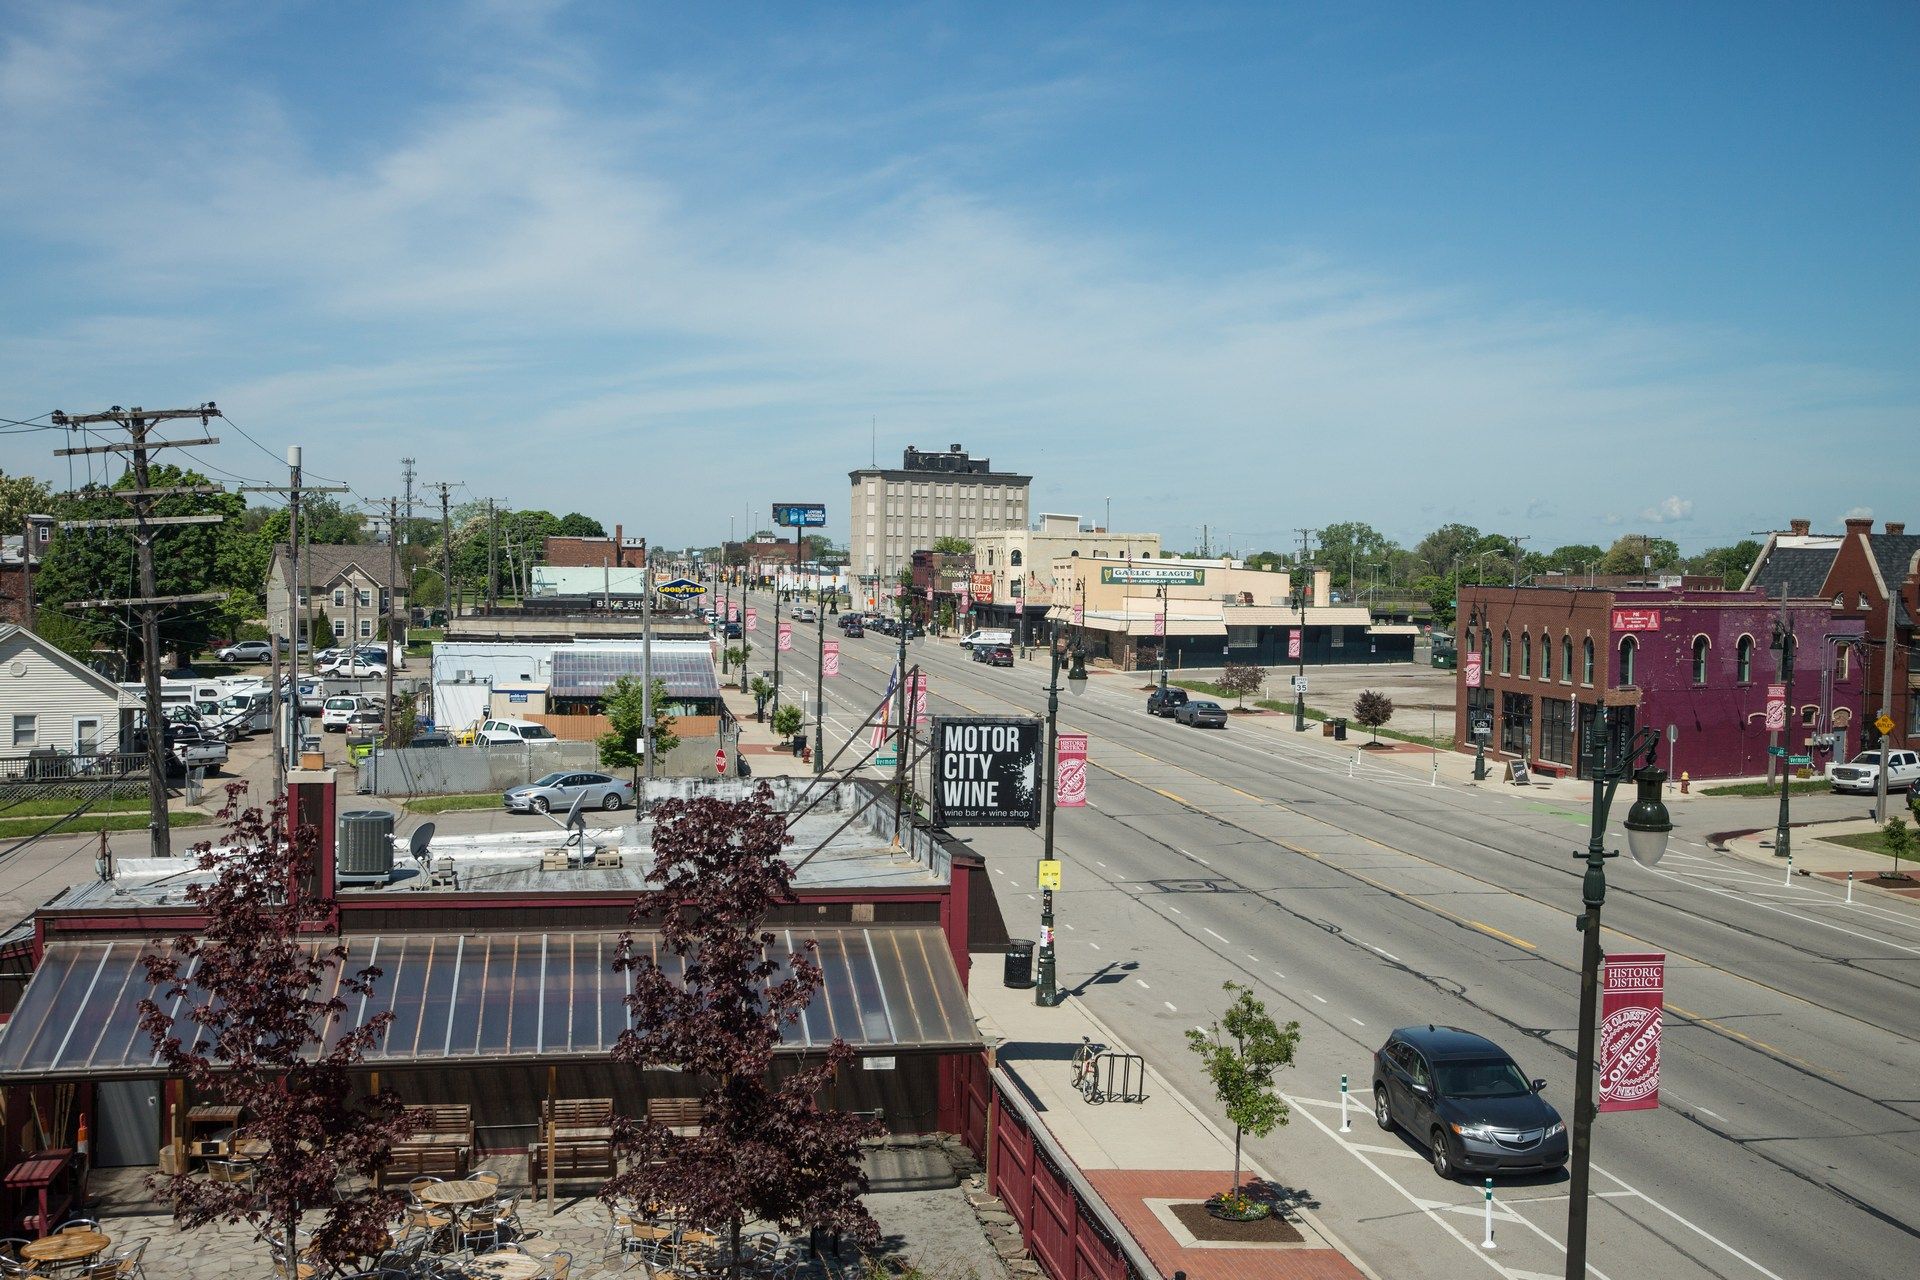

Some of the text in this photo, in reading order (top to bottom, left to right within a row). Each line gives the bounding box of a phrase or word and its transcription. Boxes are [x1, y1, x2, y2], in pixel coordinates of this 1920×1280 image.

[972, 584, 991, 592] LOANS
[944, 725, 1020, 753] MOTOR
[716, 757, 726, 766] STOP
[943, 753, 994, 780] CITY
[943, 781, 1000, 807] WINE
[944, 809, 963, 817] wine
[965, 809, 979, 817] bar
[989, 809, 1008, 817] wine
[1009, 809, 1030, 818] shop
[1608, 967, 1662, 978] HISTORIC
[1608, 977, 1661, 988] DISTRICT
[1611, 1010, 1646, 1026] OLDEST
[1609, 1032, 1631, 1055] Since
[1600, 1017, 1663, 1093] Corktown
[1632, 1055, 1651, 1075] 1834
